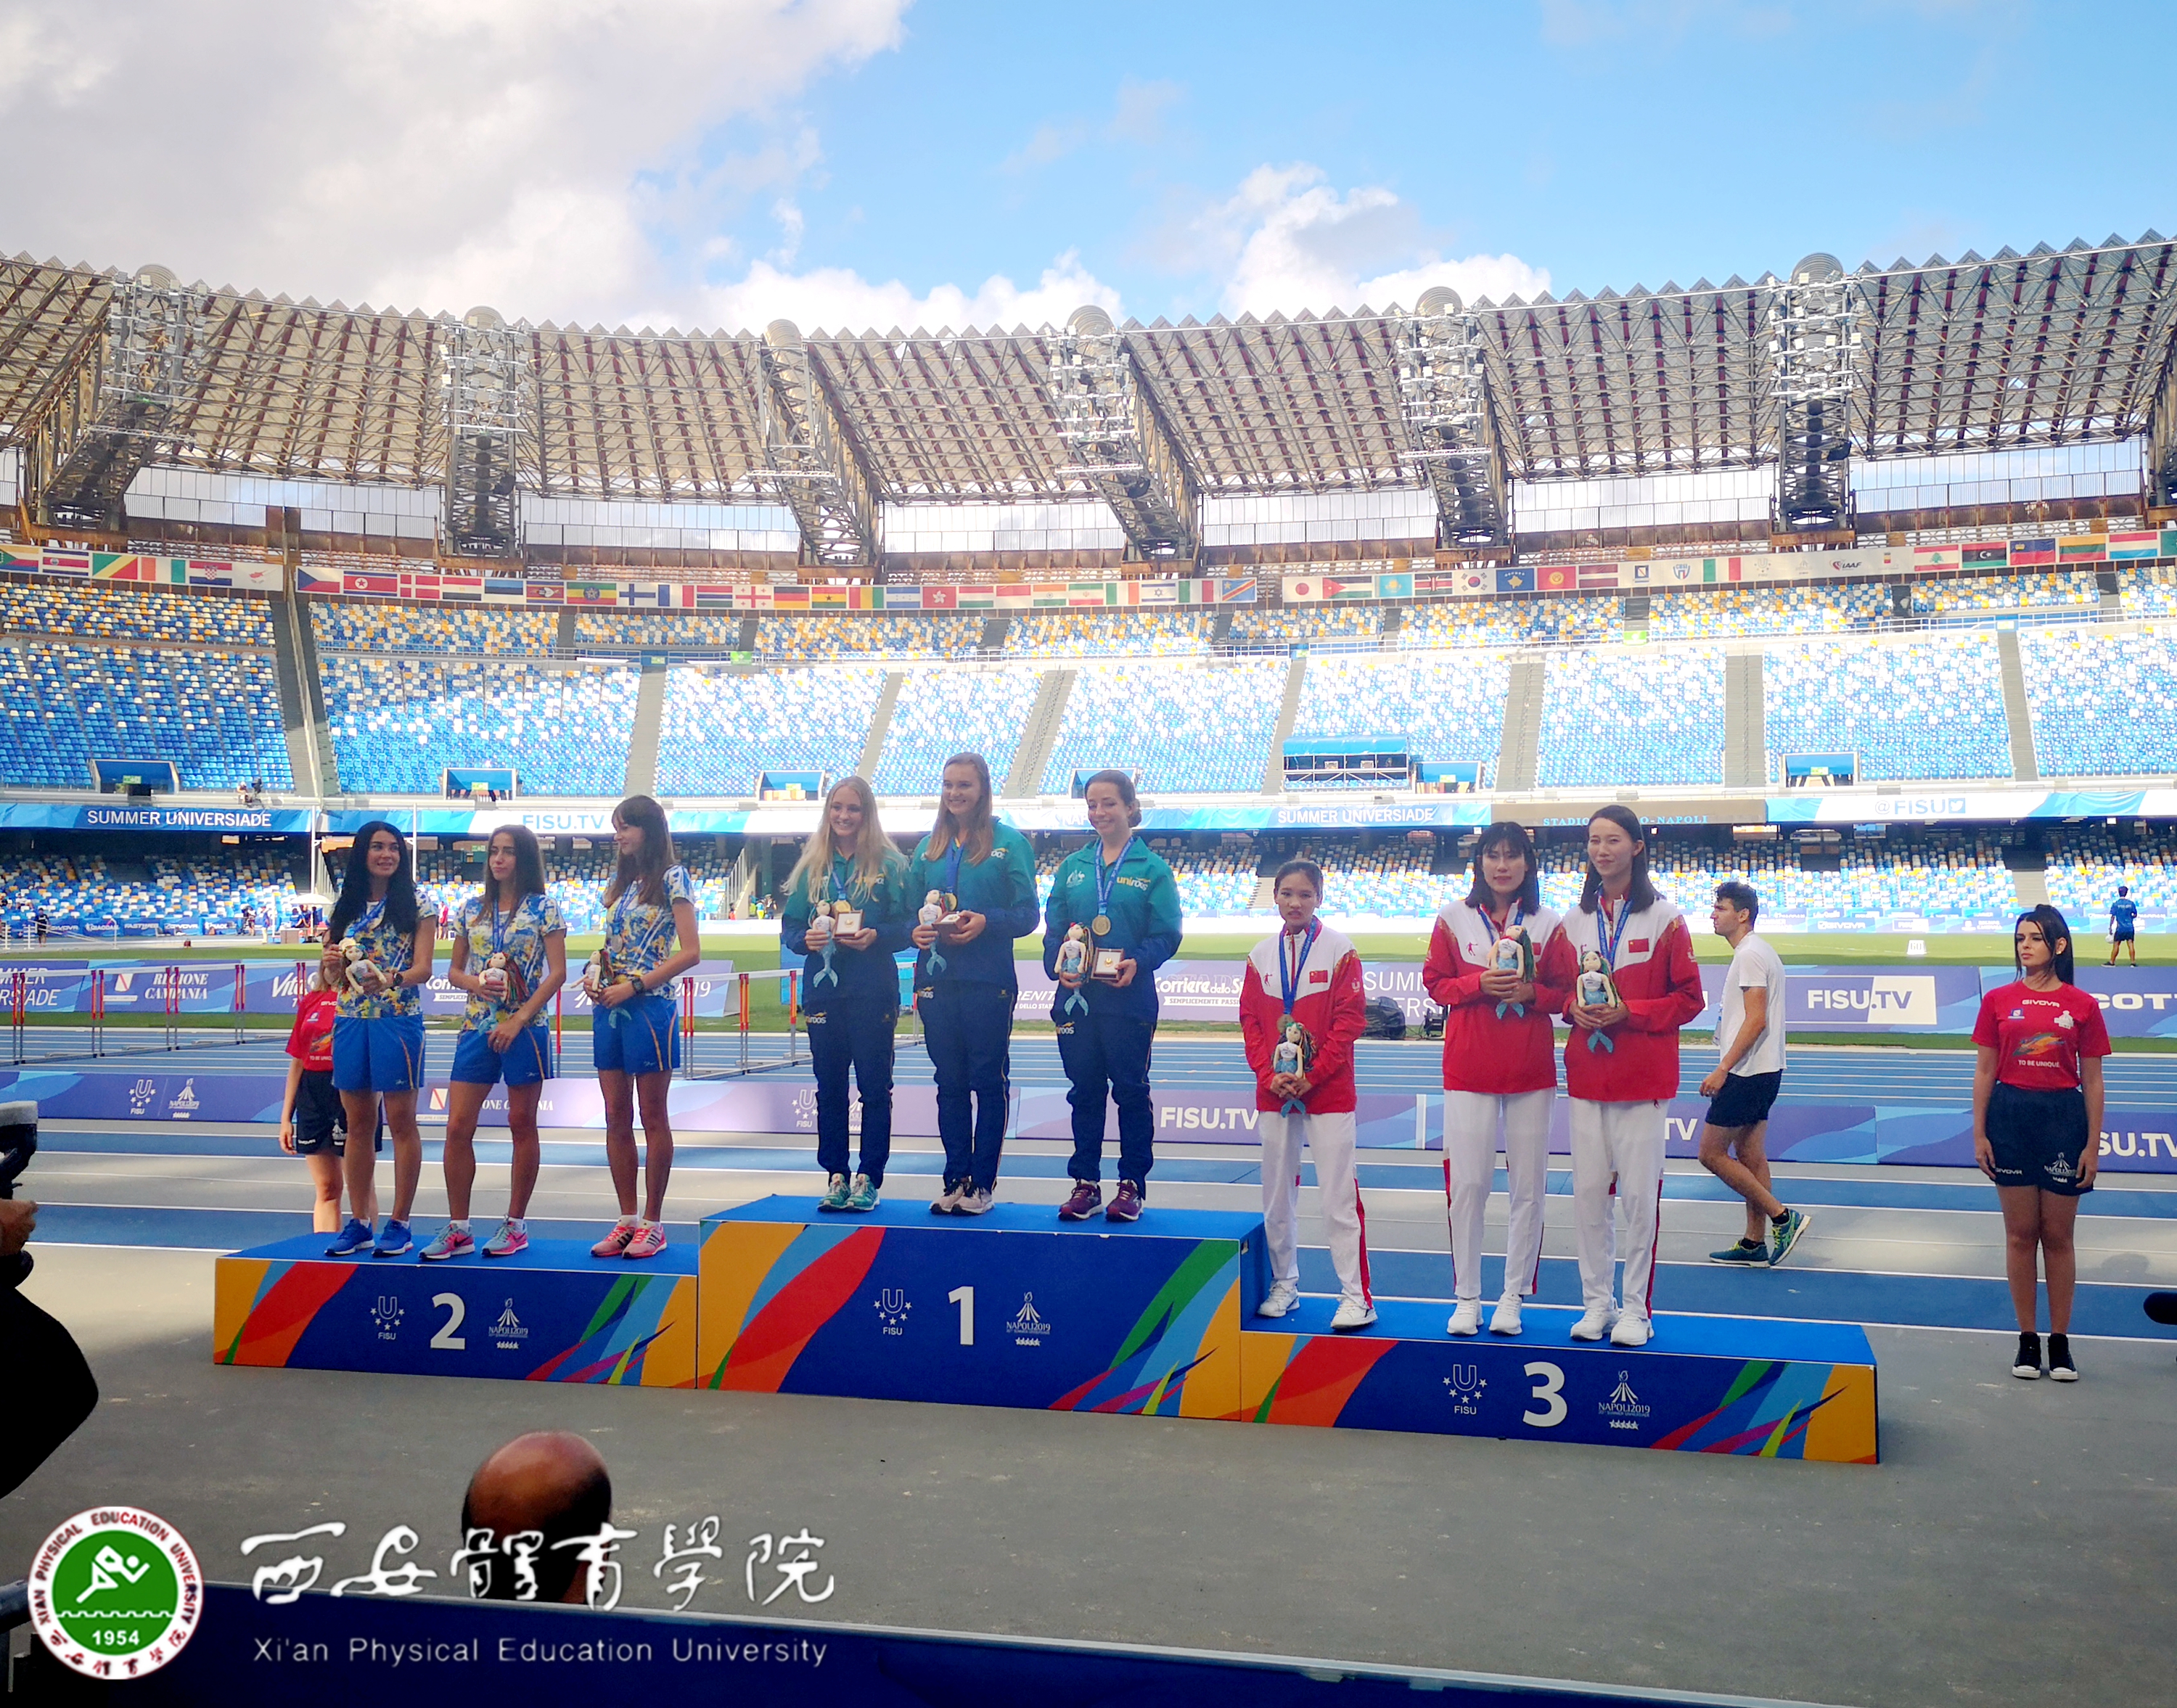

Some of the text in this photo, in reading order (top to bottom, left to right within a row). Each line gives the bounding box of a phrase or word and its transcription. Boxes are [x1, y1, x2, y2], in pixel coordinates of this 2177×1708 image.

[1875, 799, 1946, 815] @FISU
[86, 810, 272, 827] SUMMER UNIVERSIADE
[522, 814, 605, 829] FISU.TV
[1062, 814, 1088, 826] NAP
[1277, 808, 1434, 824] SUMMER UNIVERSIADE
[1640, 815, 1708, 825] O-NAPOLI
[1017, 990, 1056, 1001] RENIT
[1807, 989, 1913, 1010] FISU.TV
[2021, 998, 2060, 1008] GIVOVA
[1160, 1106, 1260, 1130] FISU.TV
[2098, 1131, 2177, 1157] SU.TV
[430, 1292, 466, 1350] 2
[948, 1286, 974, 1345] 1
[488, 1326, 529, 1335] NAPOLI2019
[882, 1326, 903, 1336] FISU
[1006, 1321, 1051, 1331] NAPOLI2019
[1522, 1361, 1568, 1428] 3
[1454, 1405, 1477, 1415] FISU
[1598, 1402, 1651, 1413] NAPOLI2019
